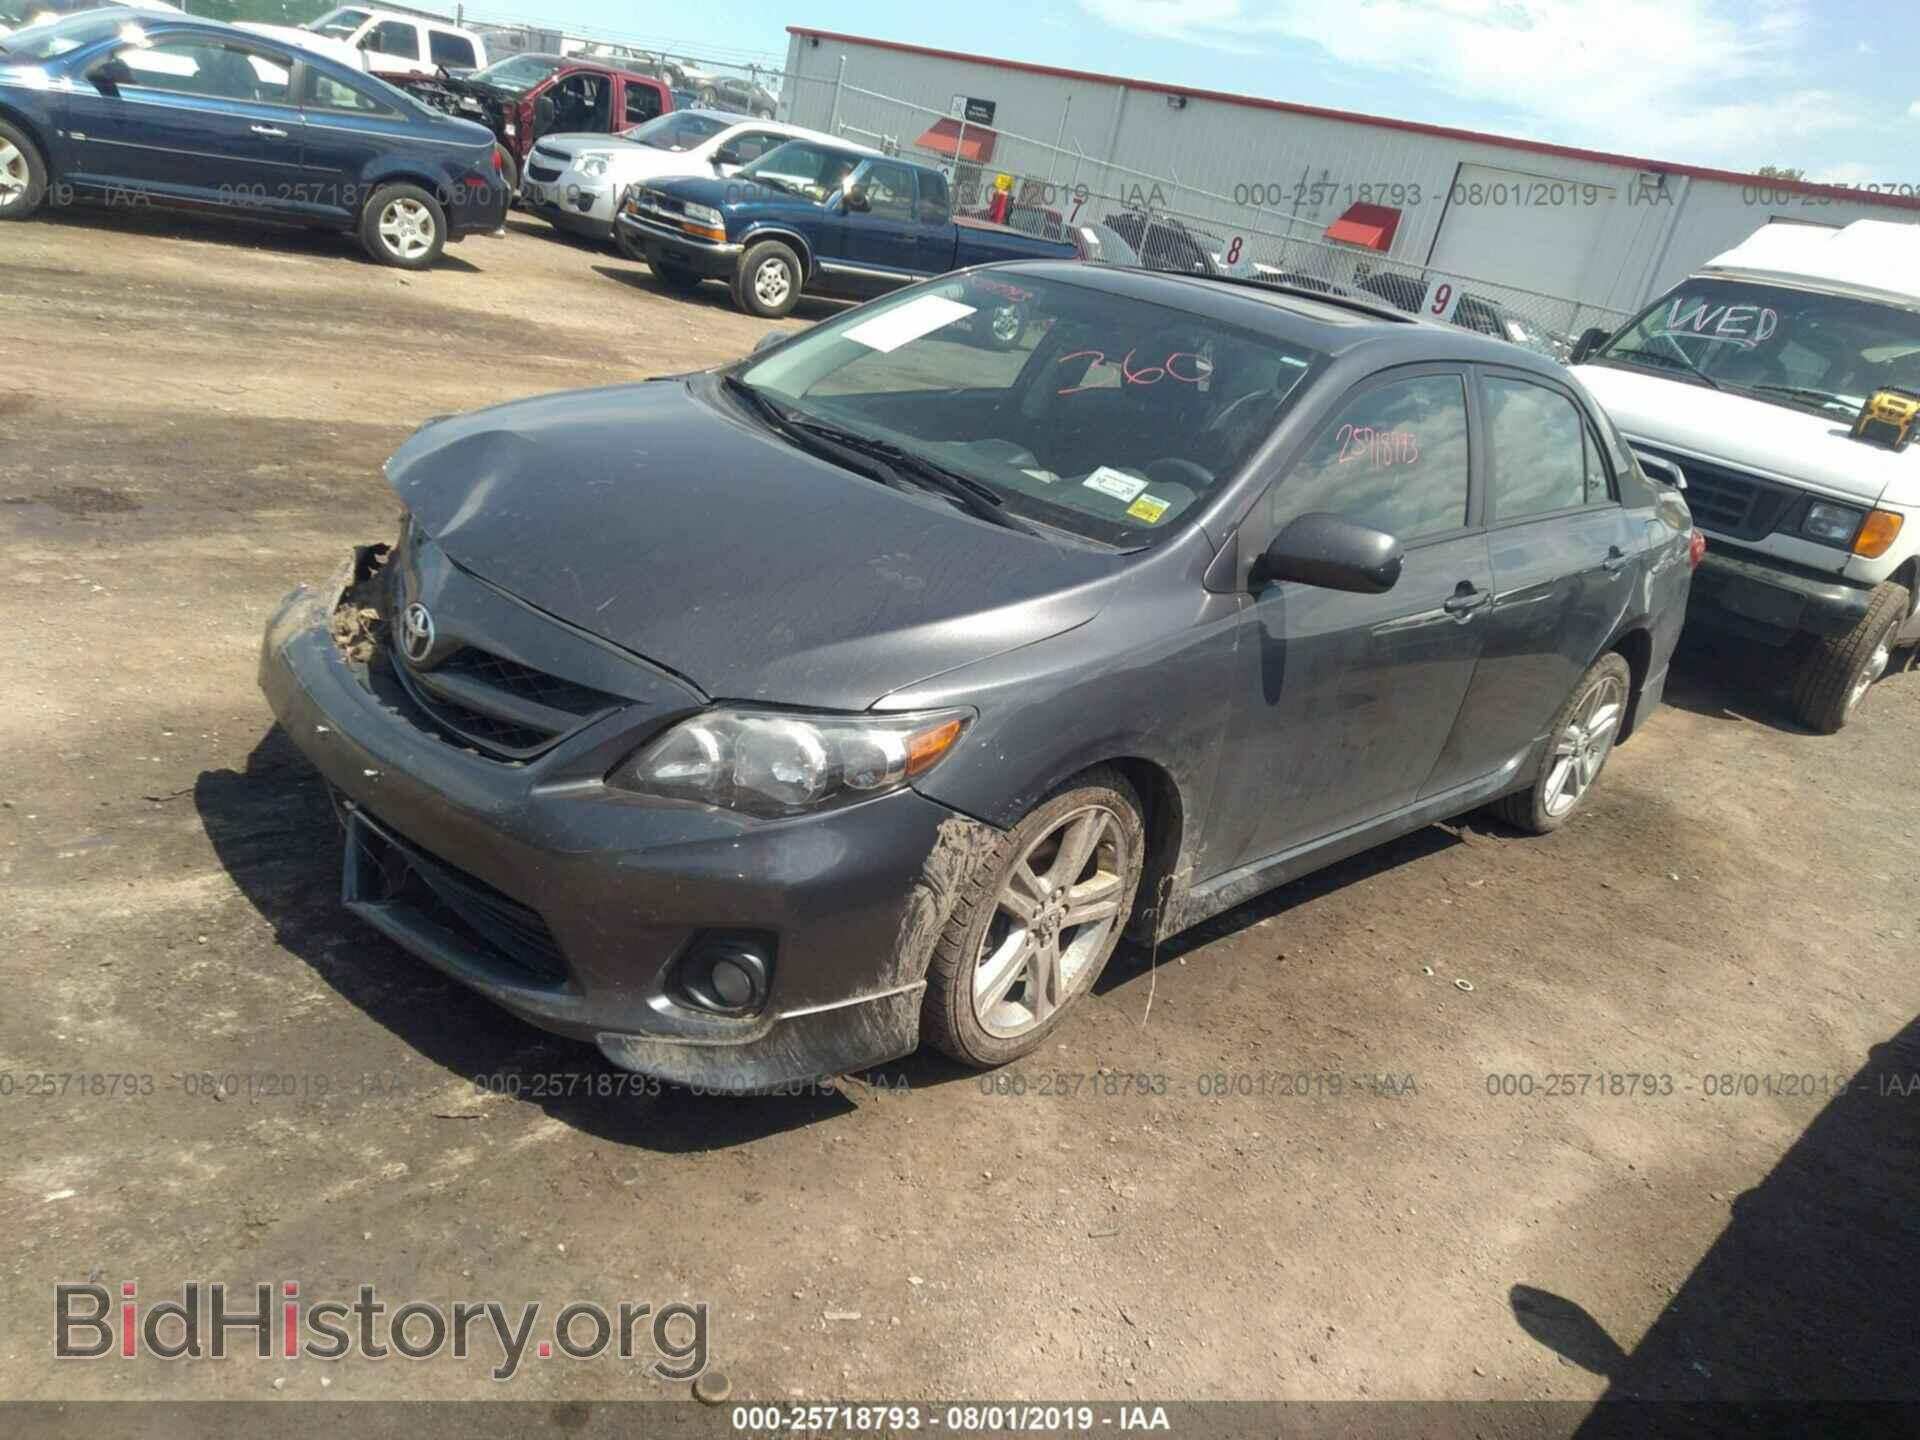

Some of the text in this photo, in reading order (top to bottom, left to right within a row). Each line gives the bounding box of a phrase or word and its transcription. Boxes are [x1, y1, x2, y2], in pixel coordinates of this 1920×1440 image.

[1227, 236, 1243, 264] 8
[1431, 284, 1452, 316] 9
[1666, 298, 1778, 342] WED
[1057, 349, 1213, 394] 360
